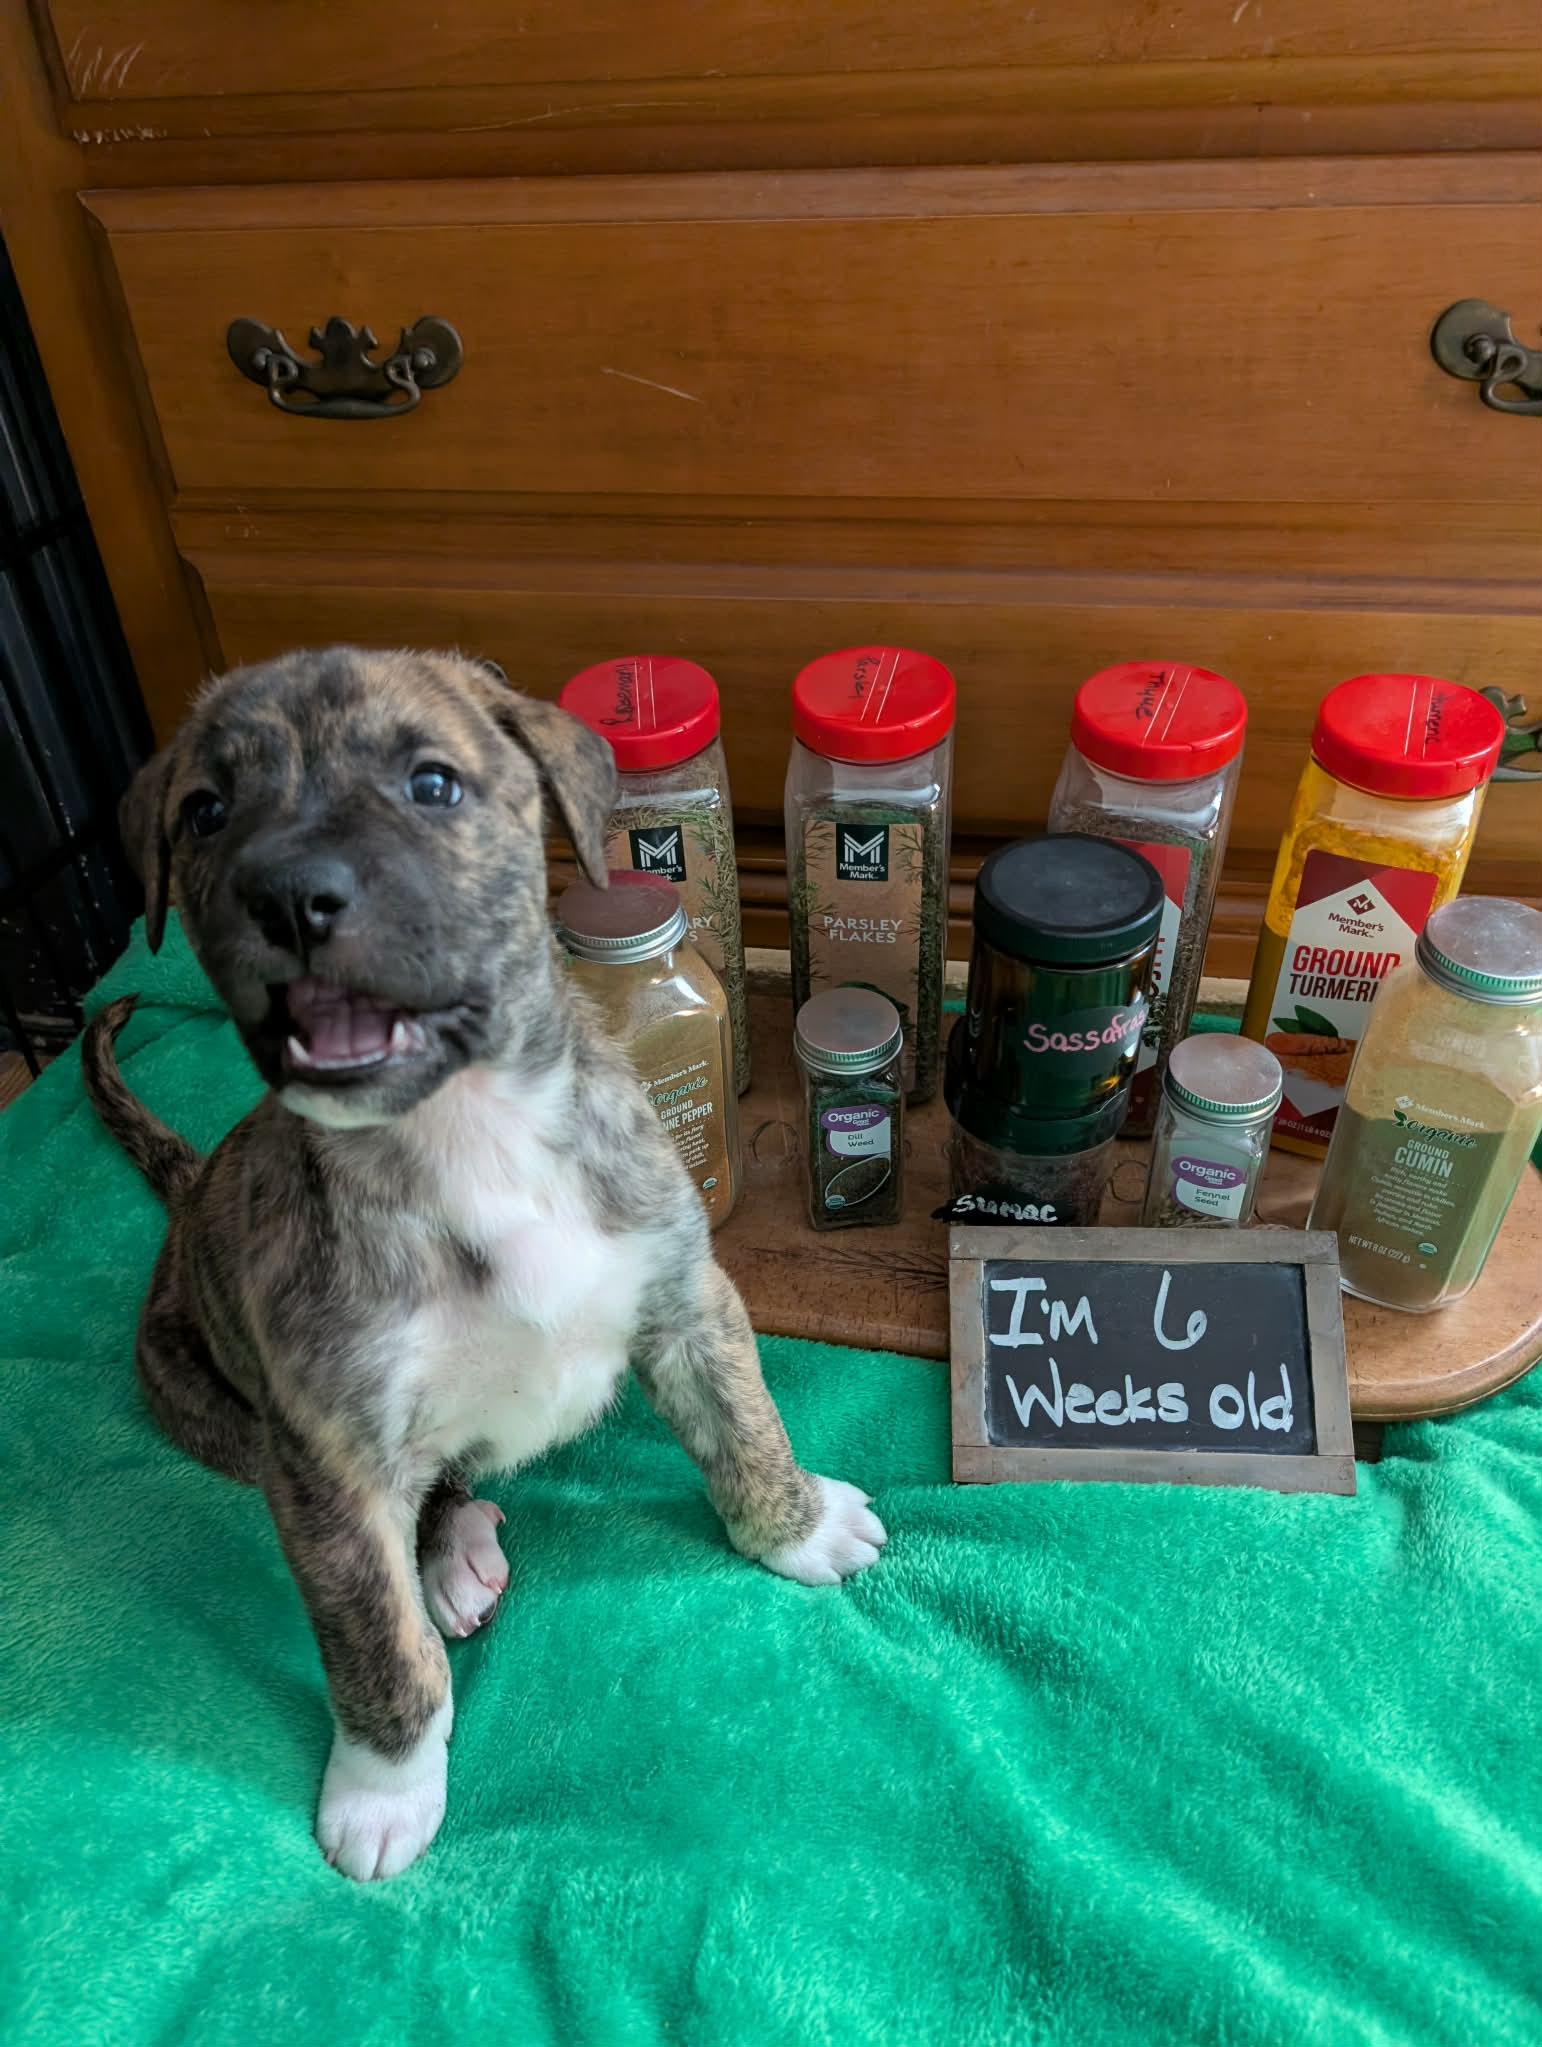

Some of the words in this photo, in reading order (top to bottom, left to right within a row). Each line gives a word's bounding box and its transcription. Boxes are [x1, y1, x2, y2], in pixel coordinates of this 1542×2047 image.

[839, 862, 885, 873] Member's
[823, 915, 903, 931] PARSLEY
[1328, 912, 1385, 933] Member's
[829, 929, 897, 944] FLAKES
[1289, 973, 1379, 1003] TURMERI
[660, 1099, 694, 1120] GROUND
[682, 1102, 713, 1125] PEPPER
[828, 1108, 880, 1124] Organic
[847, 1133, 863, 1141] Dill
[847, 1139, 874, 1148] Weed
[1407, 1139, 1450, 1159] GROUND
[1179, 1160, 1237, 1180] Organic
[1394, 1147, 1454, 1178] CUMIN
[1194, 1196, 1219, 1207] Seed
[1195, 1188, 1231, 1201] Fennel
[1348, 1233, 1362, 1246] NET
[1153, 1270, 1209, 1351] 6
[1004, 1356, 1190, 1429] Weeks
